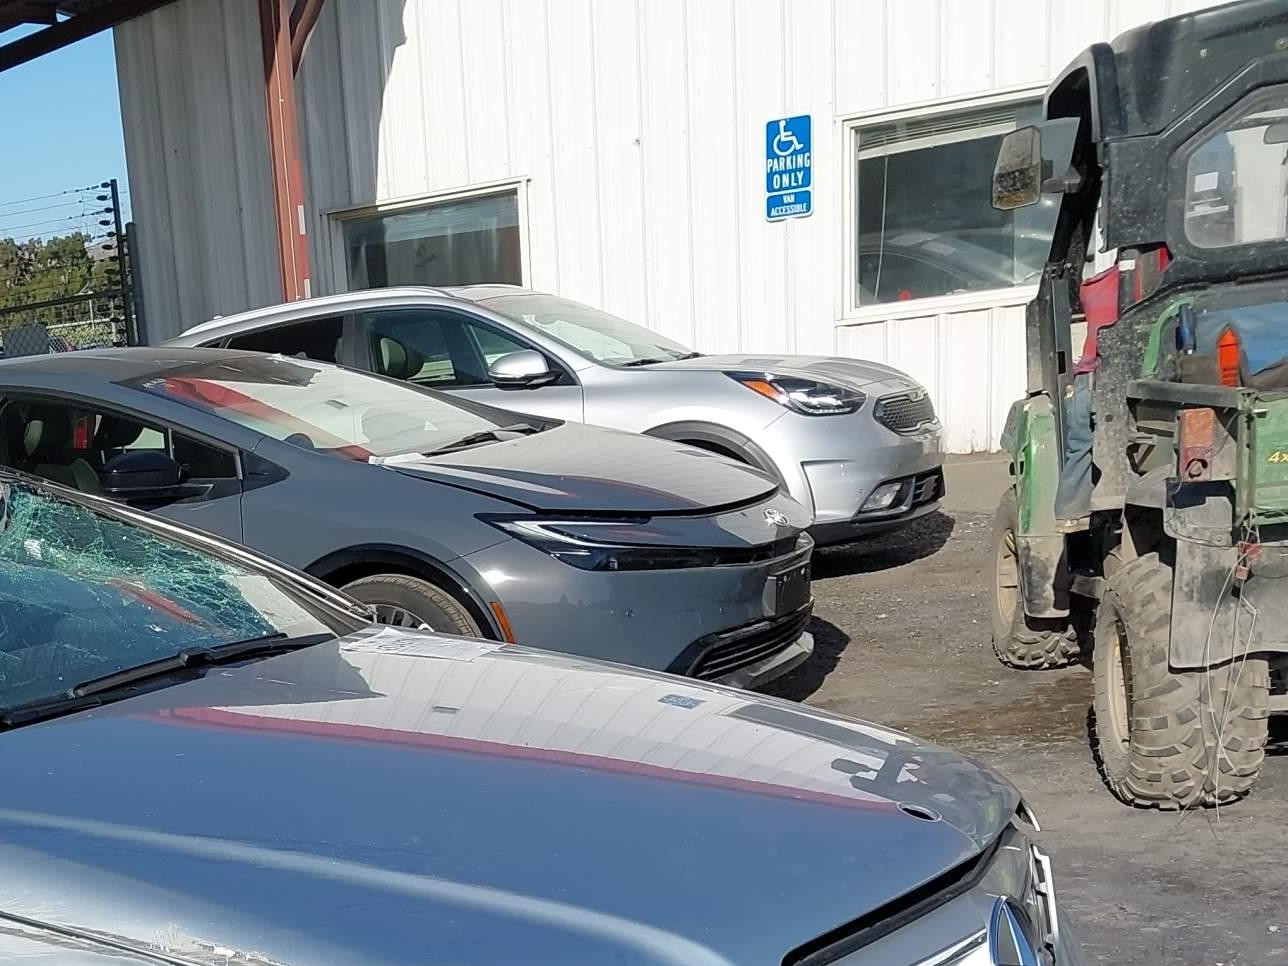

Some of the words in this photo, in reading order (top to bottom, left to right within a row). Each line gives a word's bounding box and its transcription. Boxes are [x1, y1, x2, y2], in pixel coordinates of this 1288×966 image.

[767, 152, 811, 174] PARKING
[773, 171, 804, 190] ONLY
[783, 194, 795, 204] VAN
[770, 202, 808, 217] ACCESSIBLE
